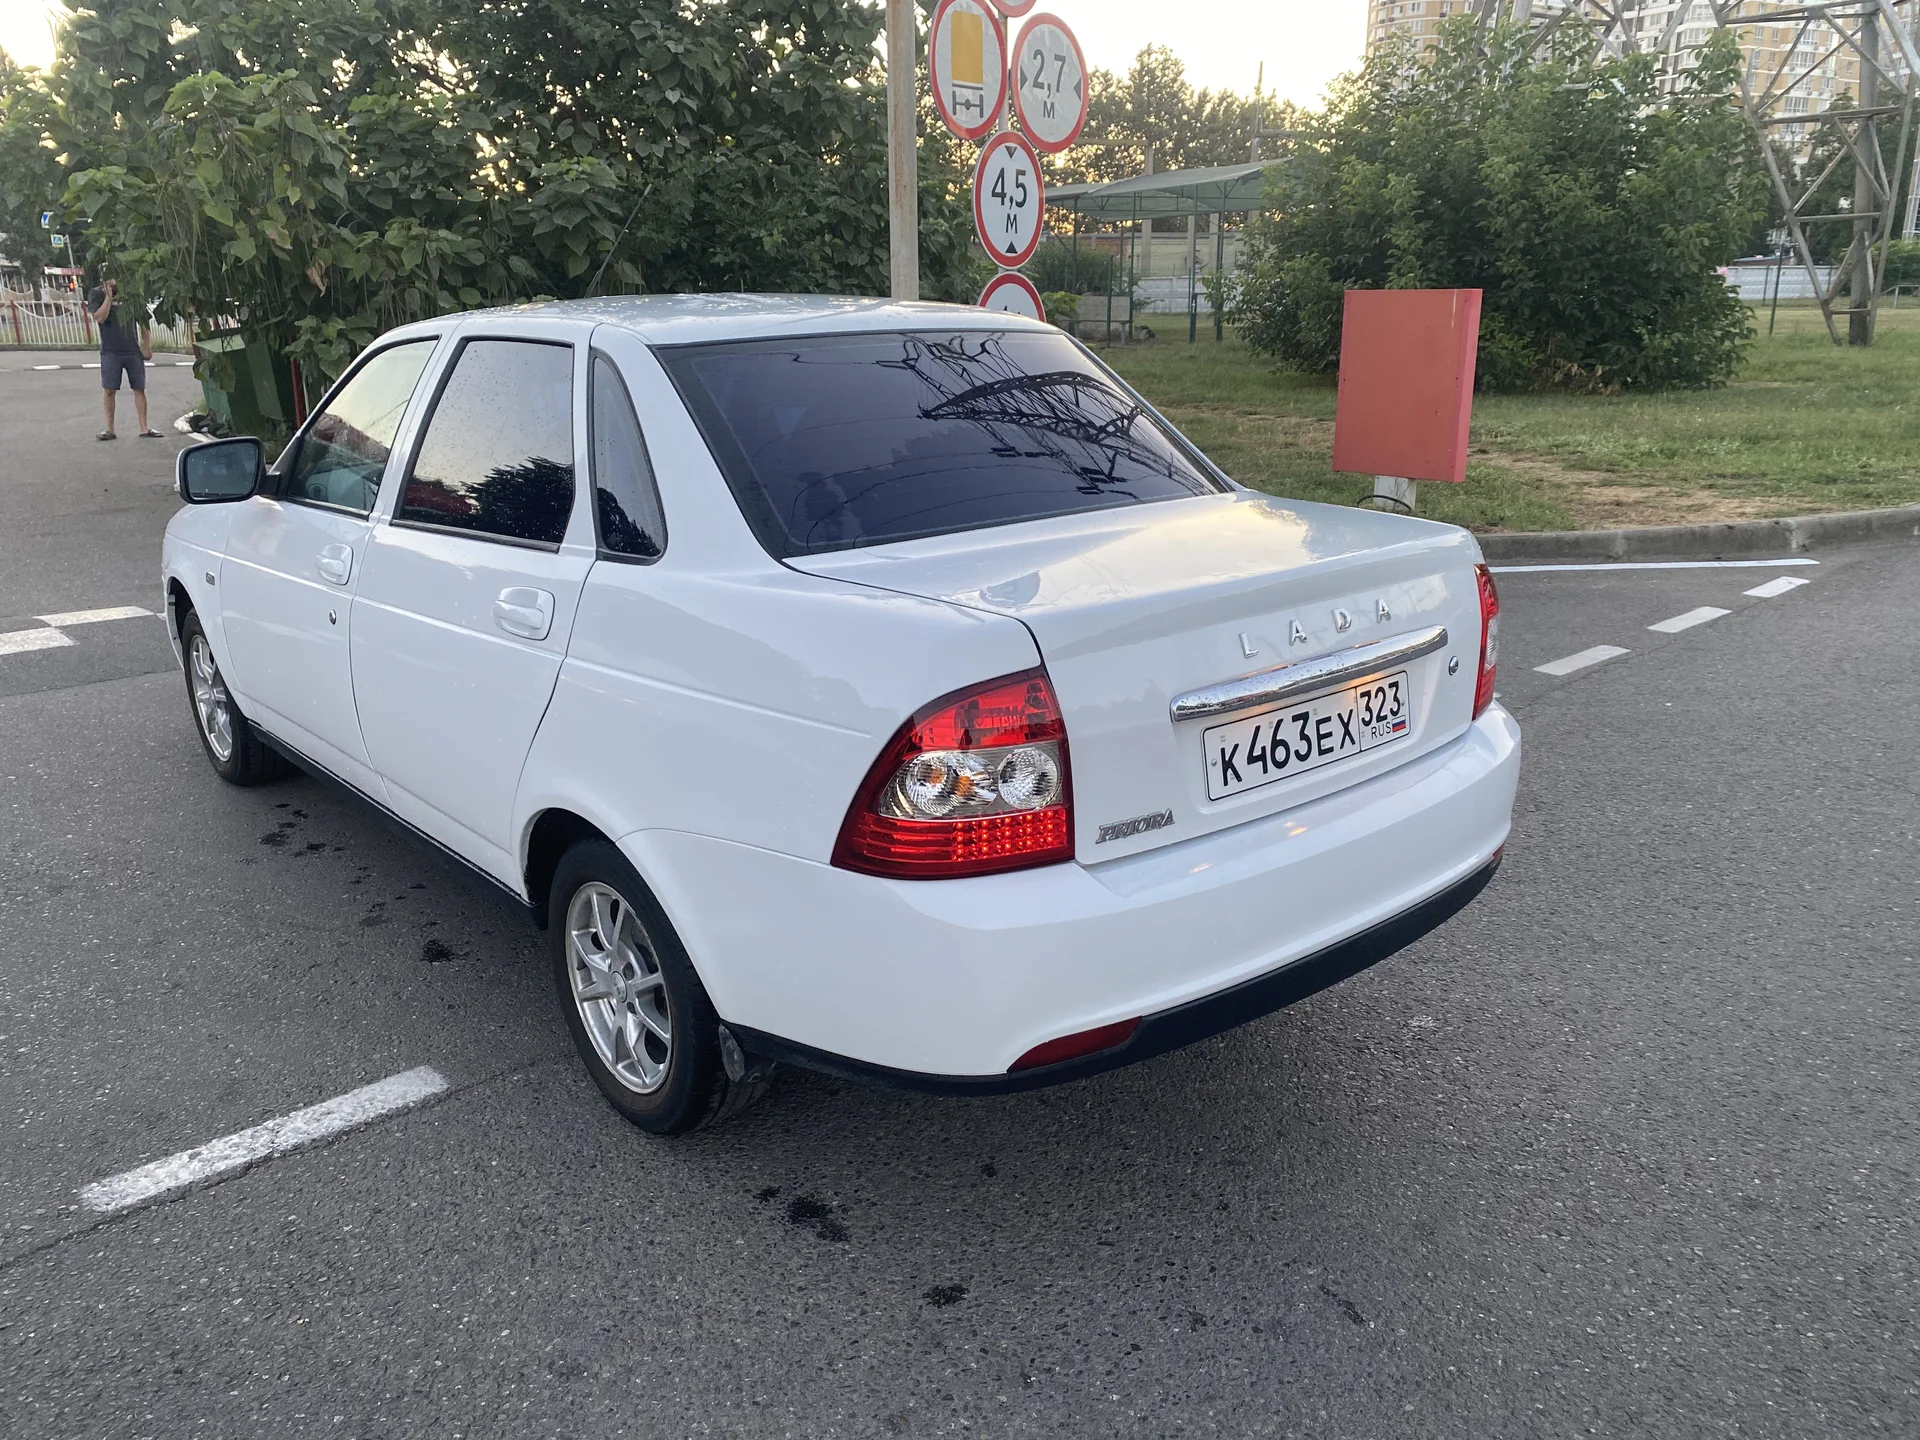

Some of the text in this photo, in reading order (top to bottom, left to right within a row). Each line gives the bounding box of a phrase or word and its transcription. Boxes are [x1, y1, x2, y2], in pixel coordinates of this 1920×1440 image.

[1033, 49, 1066, 99] 2,7
[991, 167, 1028, 210] 4,5
[1239, 599, 1392, 659] LADA
[1360, 680, 1401, 727] 323
[1371, 721, 1392, 740] RUS
[1095, 808, 1176, 845] PRIORA
